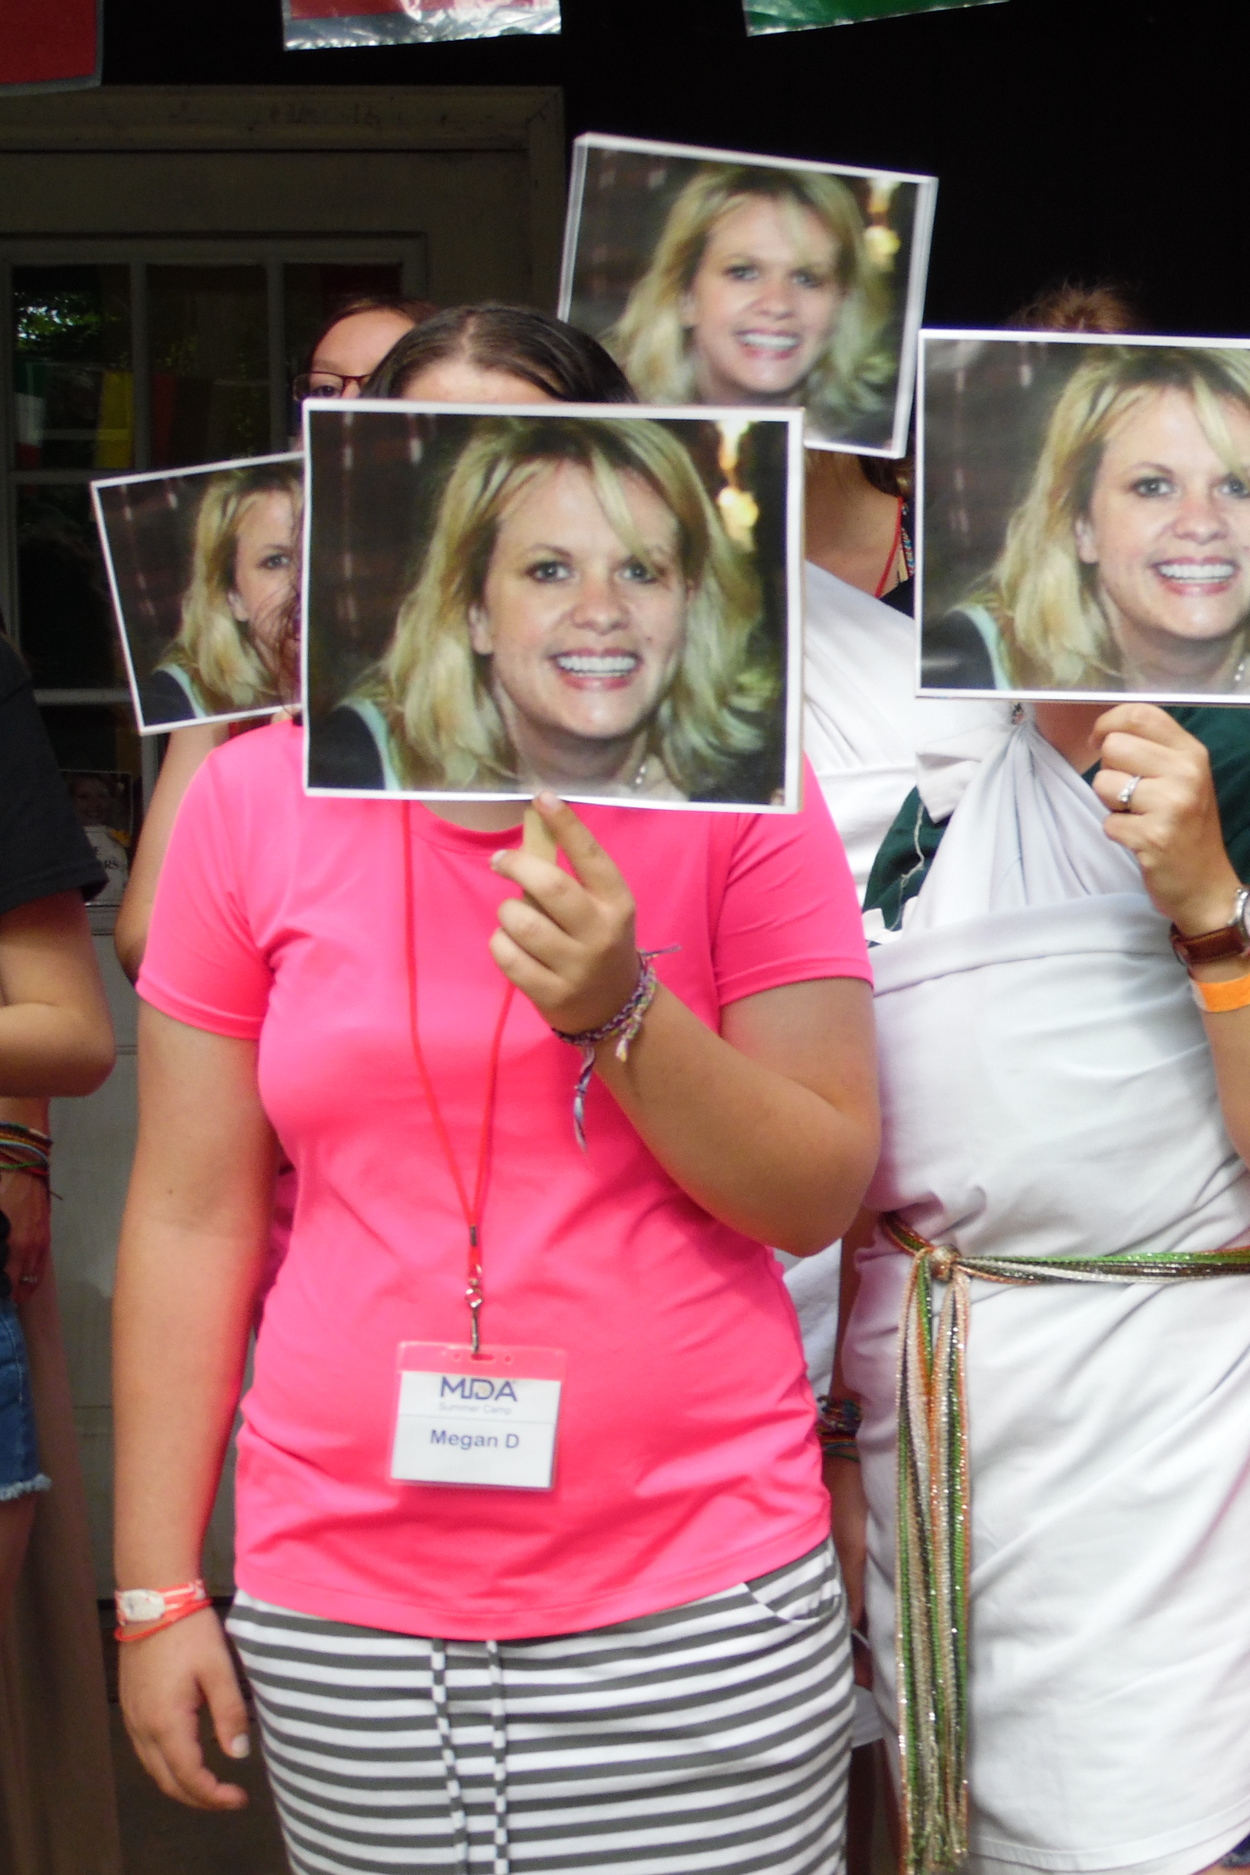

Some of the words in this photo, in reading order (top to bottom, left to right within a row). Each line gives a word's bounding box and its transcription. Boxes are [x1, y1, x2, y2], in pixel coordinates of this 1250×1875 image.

[440, 1376, 518, 1402] MDA
[439, 1401, 479, 1413] Summer
[483, 1403, 512, 1415] Camp
[429, 1429, 498, 1450] Megan
[505, 1433, 520, 1449] D
